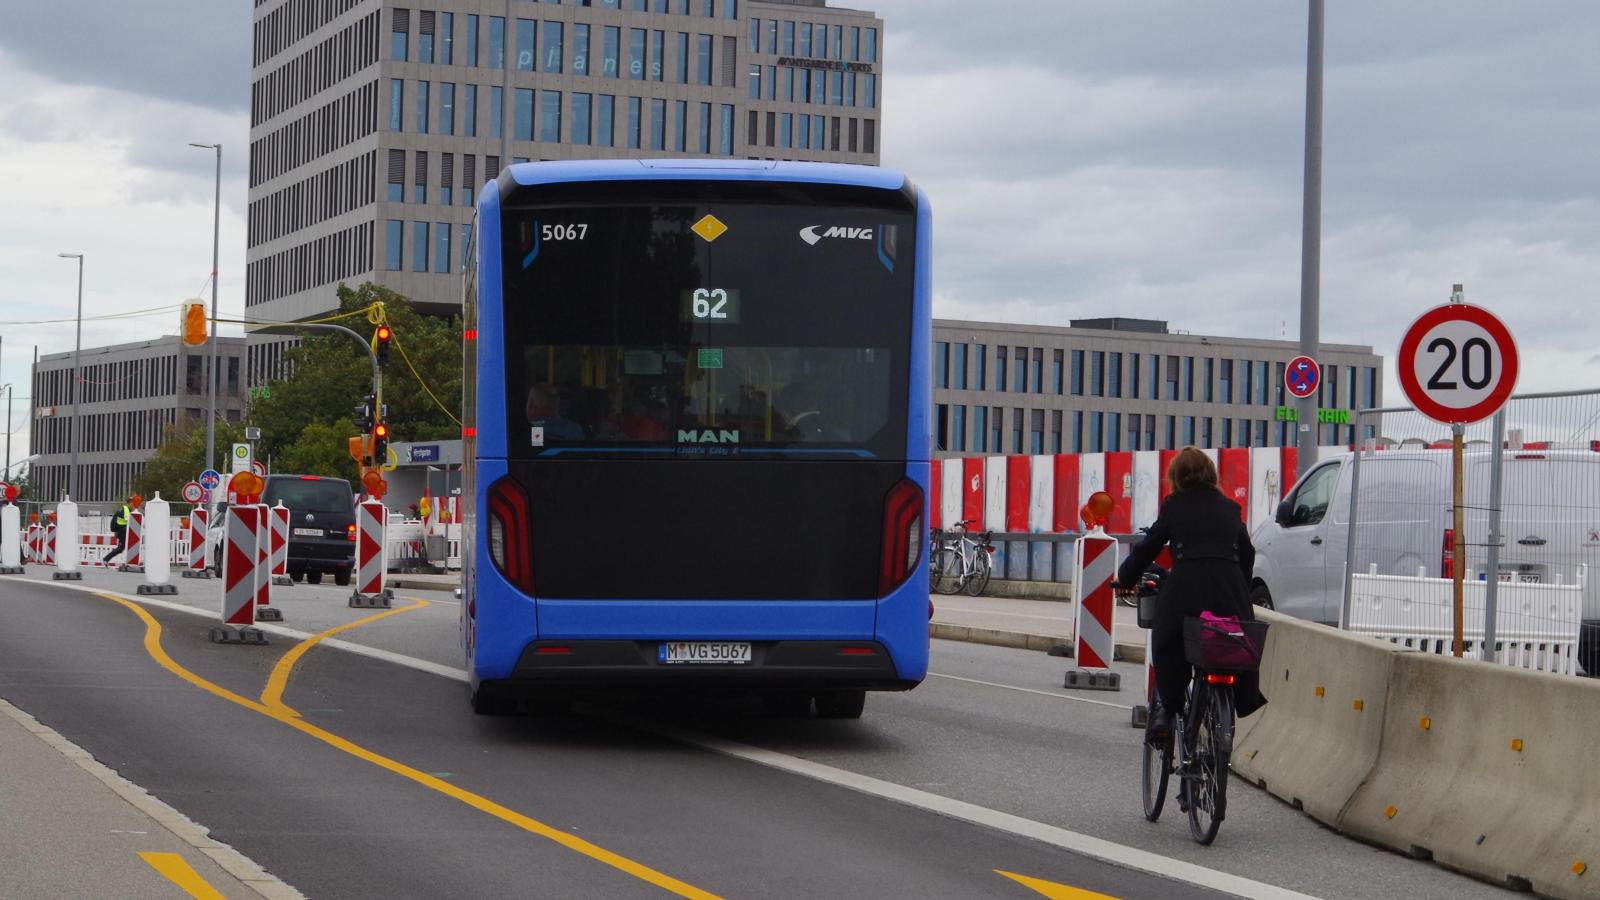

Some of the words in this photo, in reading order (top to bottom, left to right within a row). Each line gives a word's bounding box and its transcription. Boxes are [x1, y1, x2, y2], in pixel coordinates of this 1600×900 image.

[542, 223, 588, 241] 5067
[821, 226, 873, 240] MVG
[692, 288, 728, 319] 62
[1426, 337, 1492, 390] 20
[677, 429, 740, 443] MAN
